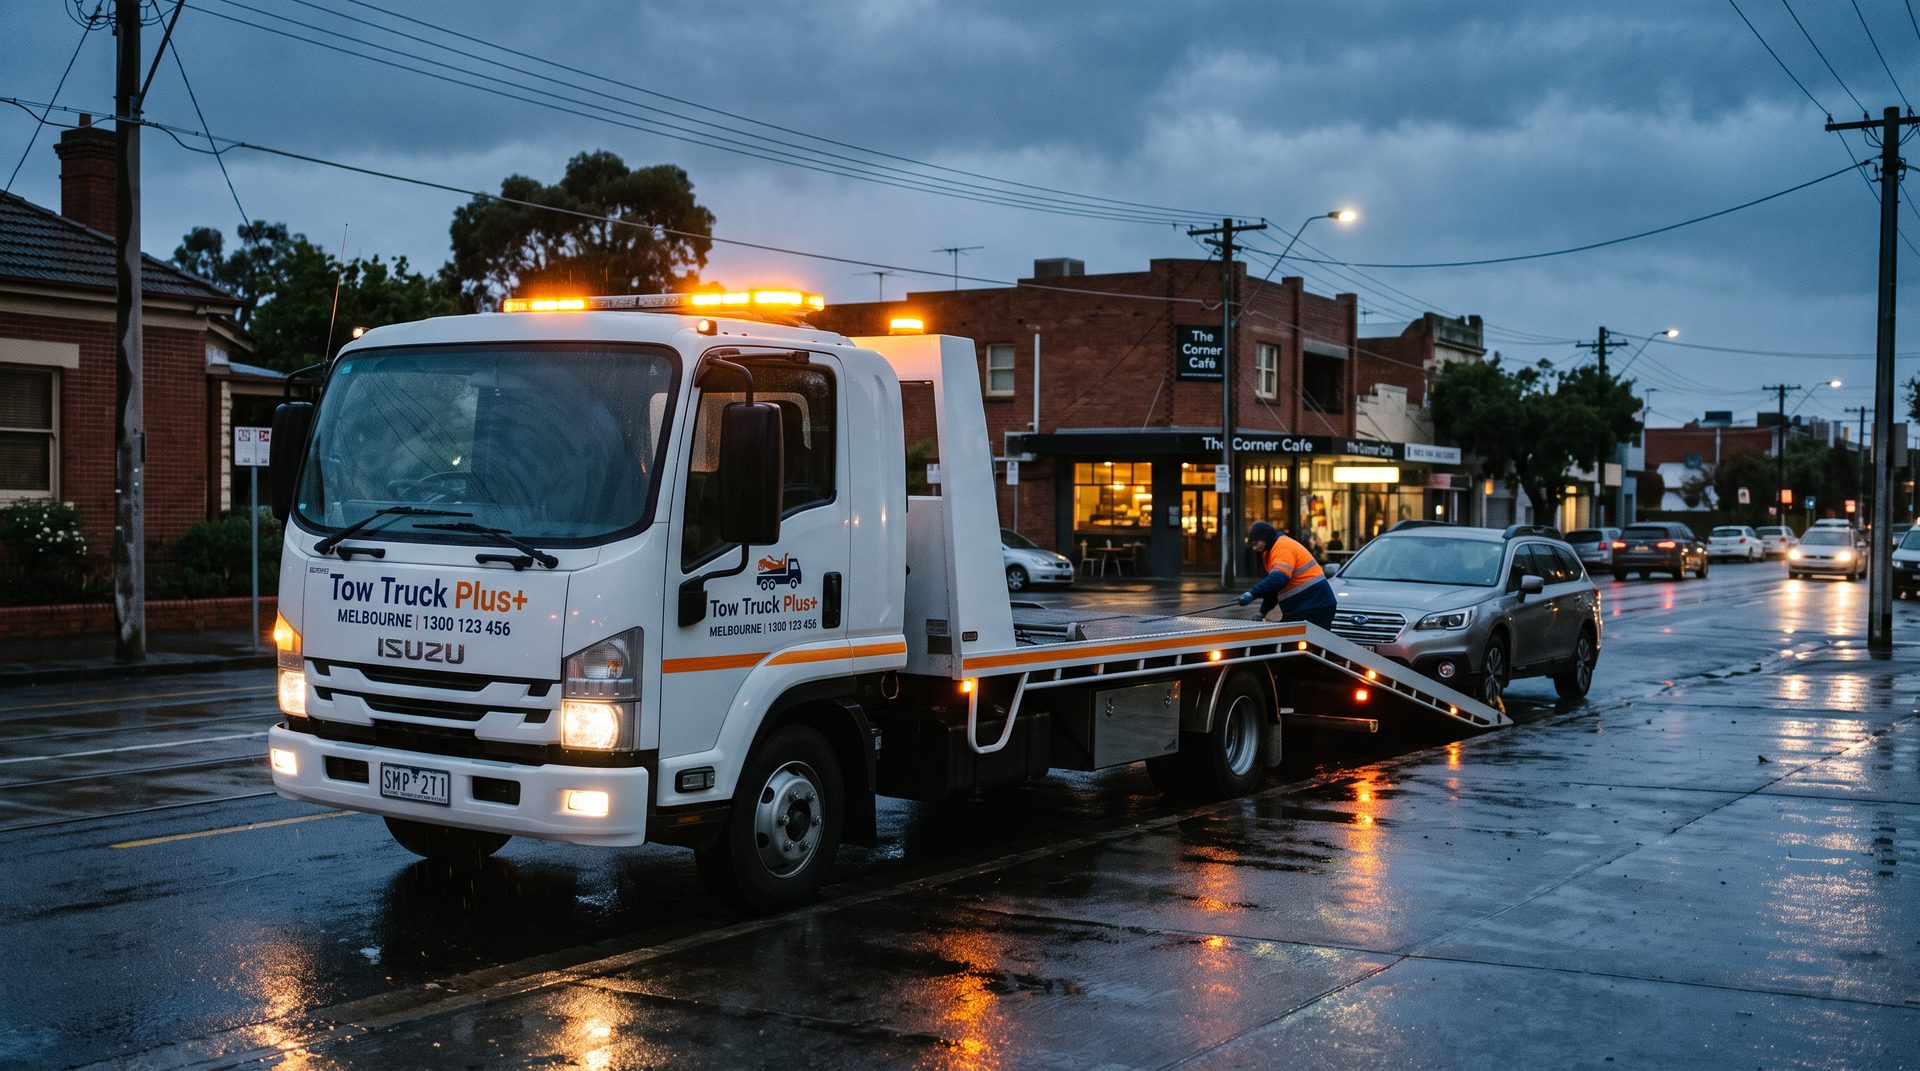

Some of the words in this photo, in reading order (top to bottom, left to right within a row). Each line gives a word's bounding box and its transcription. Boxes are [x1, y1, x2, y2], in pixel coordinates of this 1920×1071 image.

[1192, 330, 1214, 342] The
[1182, 343, 1223, 355] Corner
[1189, 357, 1216, 369] Café
[1232, 437, 1279, 451] Corner
[1281, 438, 1313, 452] Cafe
[330, 573, 374, 602] Tow
[380, 576, 448, 608] Truck
[455, 580, 528, 613] Plus+
[710, 599, 739, 618] Tow
[742, 595, 780, 615] Truck
[783, 593, 818, 613] Plus+
[337, 608, 413, 628] MELBOURNE
[423, 615, 454, 632] 1300
[458, 618, 482, 634] 123
[485, 620, 511, 637] 456
[709, 623, 762, 637] MELBOURNE
[768, 621, 787, 632] 1300
[788, 620, 802, 631] 123
[803, 619, 817, 630] 456
[377, 636, 465, 665] ISUZU
[384, 769, 410, 791] SMP
[421, 774, 445, 797] 271
